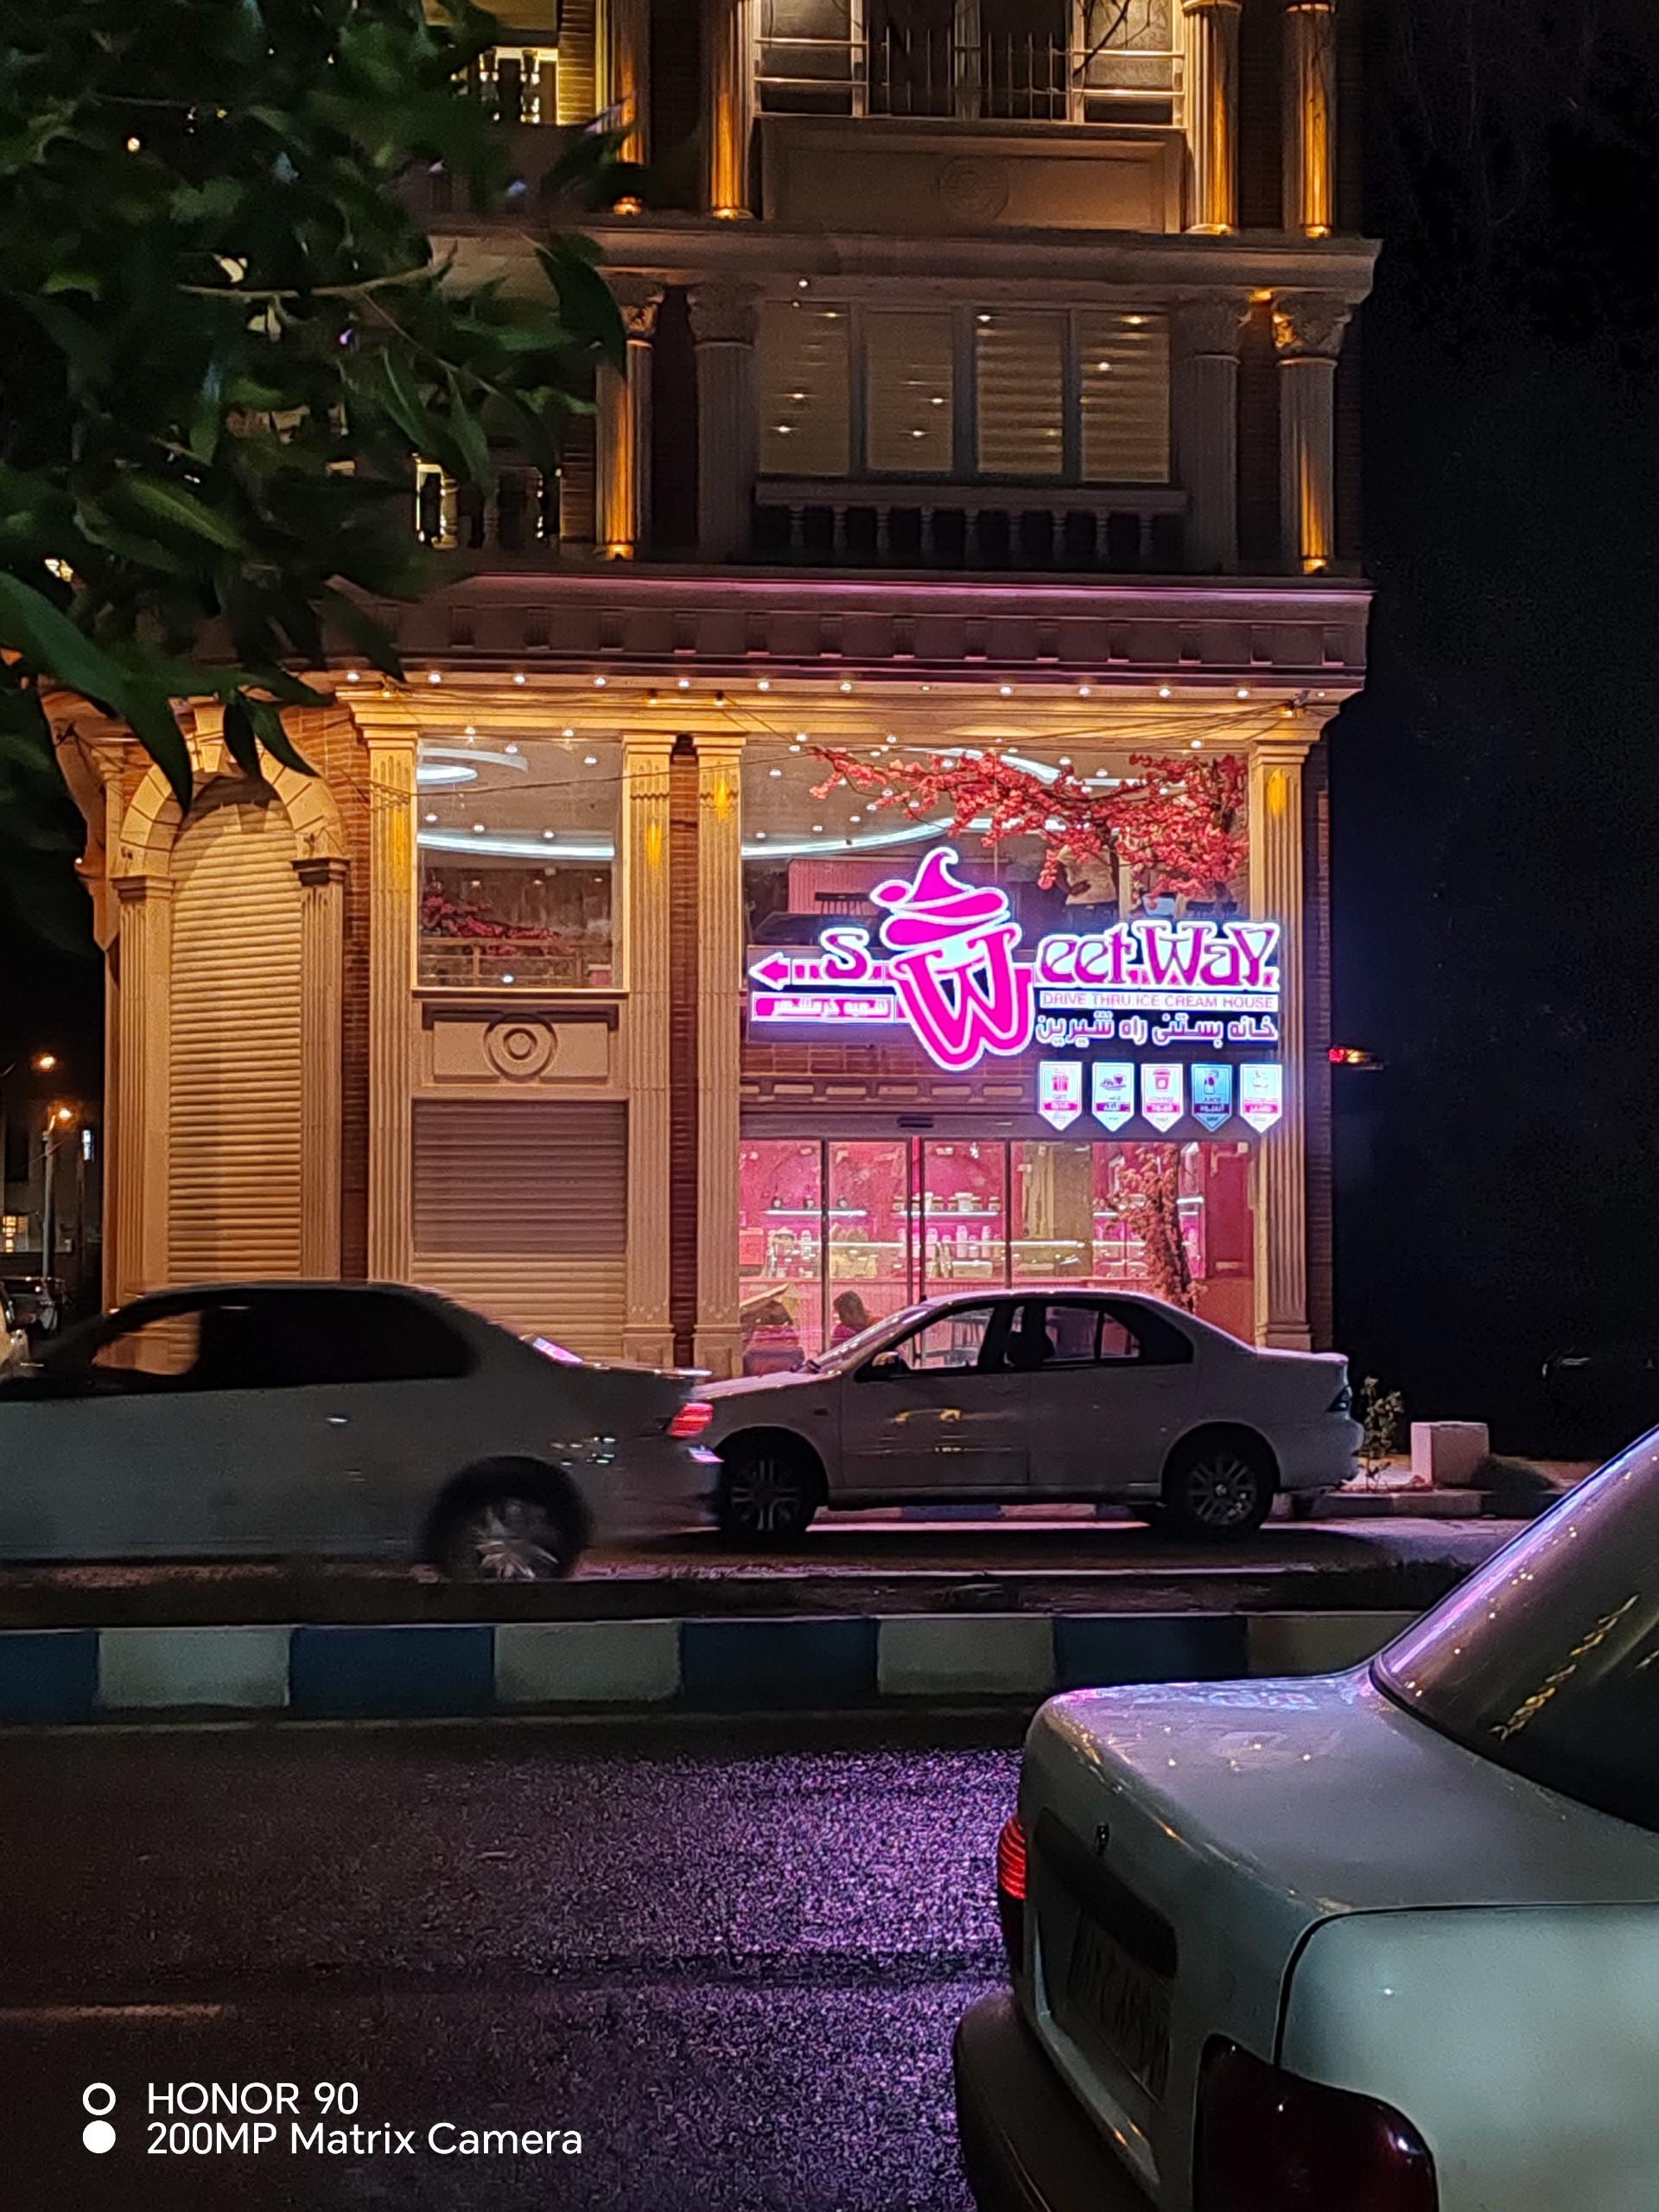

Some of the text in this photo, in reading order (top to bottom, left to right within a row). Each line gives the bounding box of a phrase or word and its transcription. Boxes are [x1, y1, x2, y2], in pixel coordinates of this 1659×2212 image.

[1042, 992, 1274, 1009] DRIVE THRU ICE CREAM HOUSE
[1035, 1010, 1278, 1048] خانه بستنی راه شیرین
